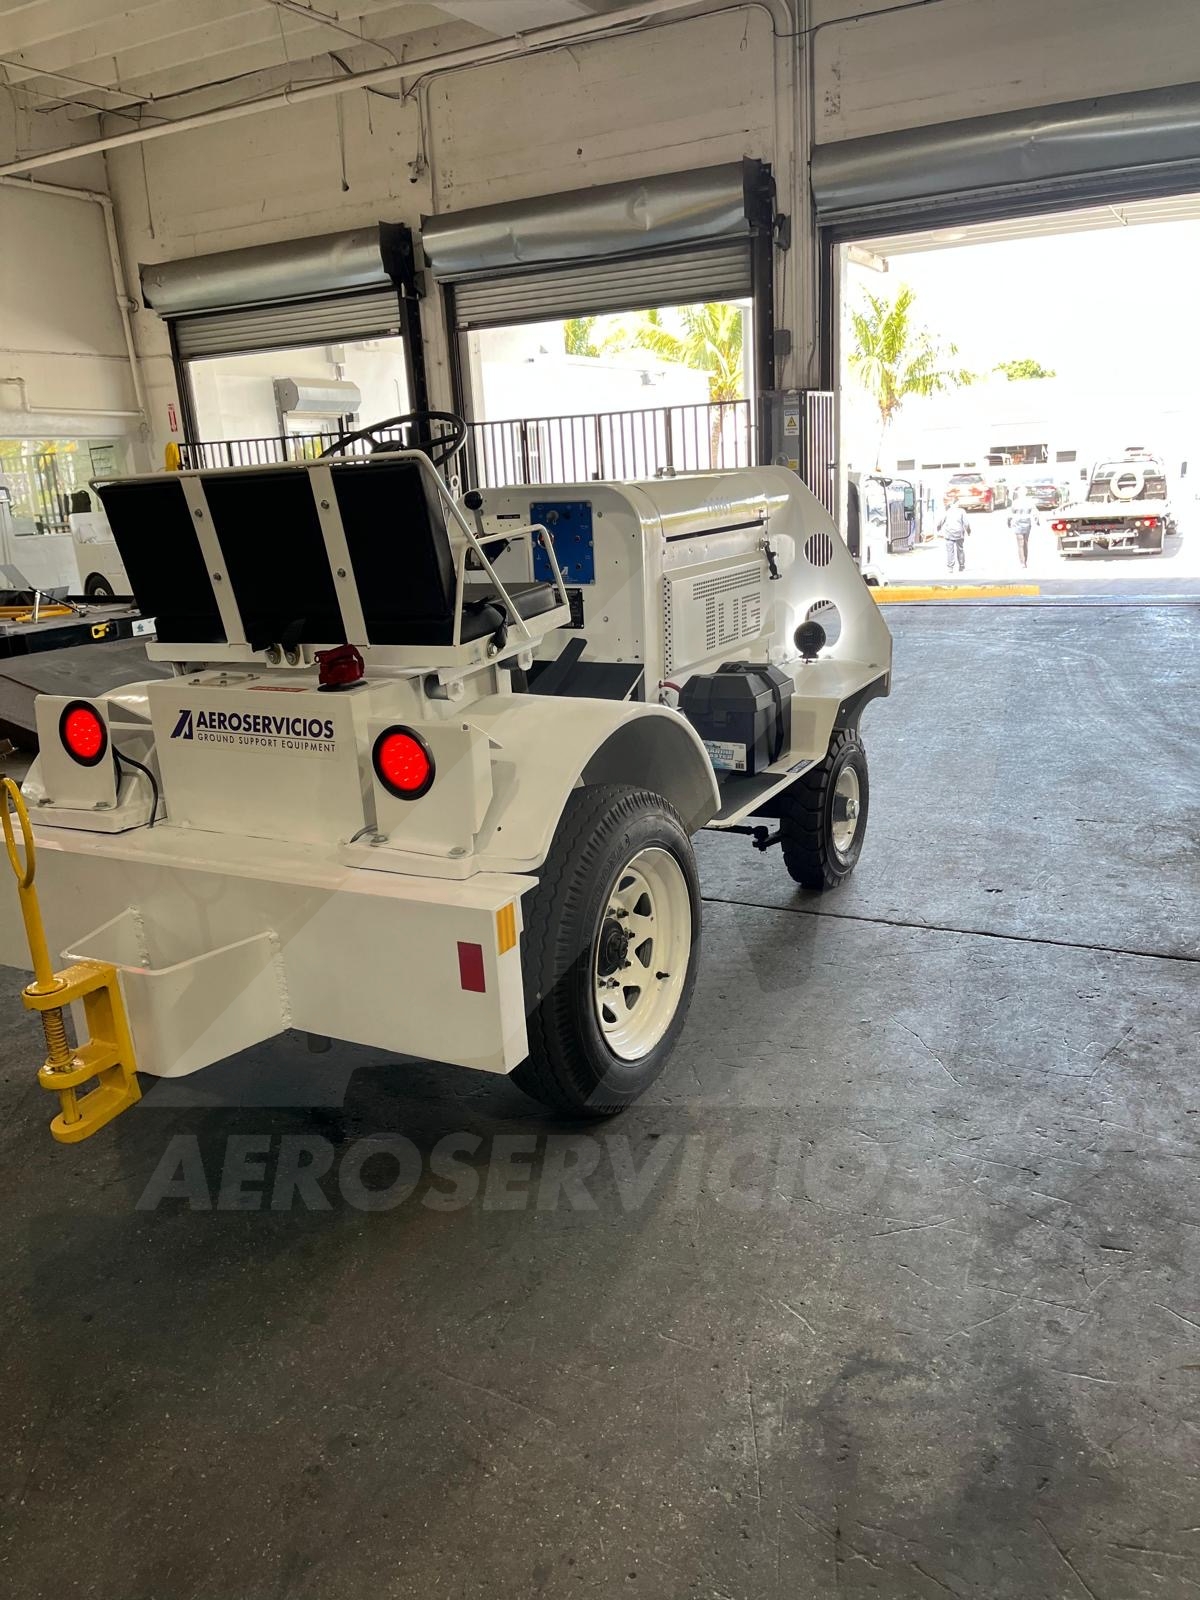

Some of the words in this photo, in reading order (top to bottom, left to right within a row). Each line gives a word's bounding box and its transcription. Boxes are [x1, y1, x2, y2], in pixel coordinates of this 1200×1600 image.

[693, 567, 761, 651] TUG
[196, 711, 334, 739] AEROSERVICIOS
[197, 733, 235, 744] GROUND
[239, 736, 278, 748] SUPPORT
[281, 740, 336, 753] EQUIPMENT
